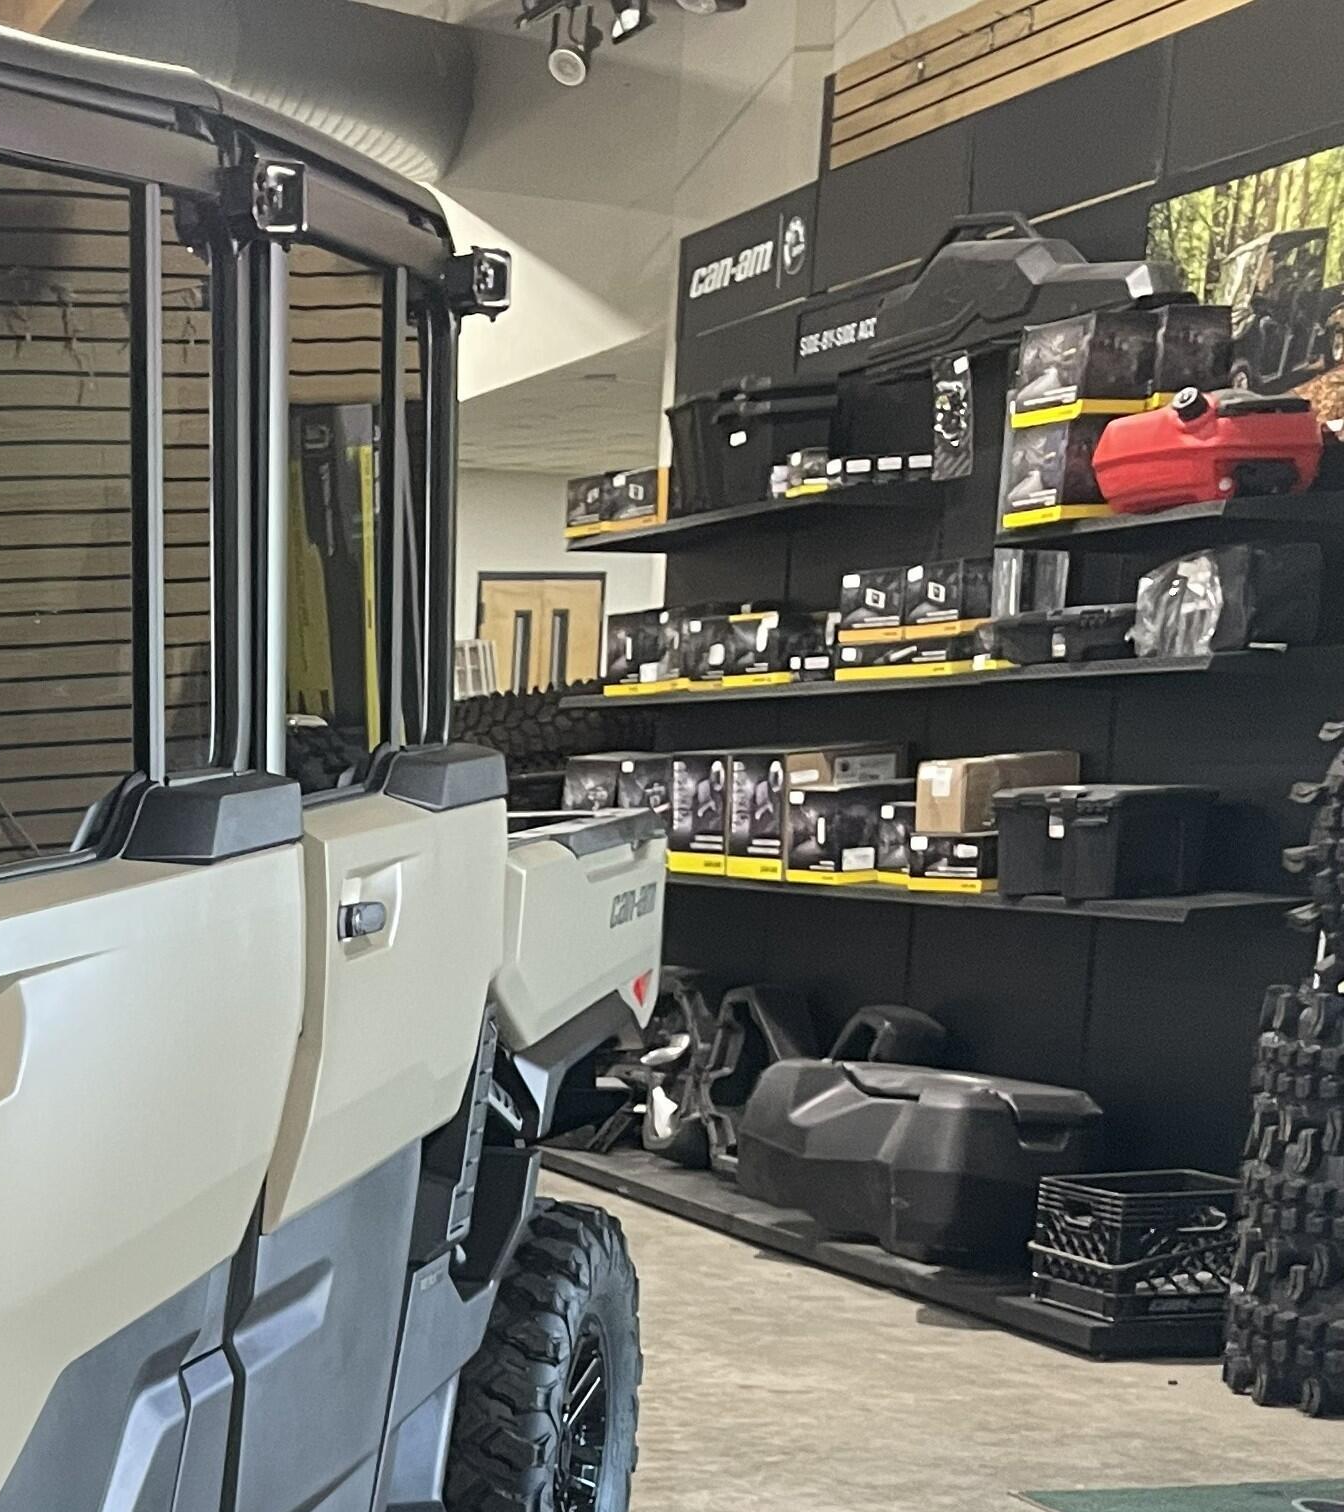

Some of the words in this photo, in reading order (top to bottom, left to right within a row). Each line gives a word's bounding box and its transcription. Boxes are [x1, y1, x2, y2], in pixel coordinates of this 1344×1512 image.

[689, 240, 774, 299] can-am
[799, 323, 857, 357] SIDE-BY-SIDE
[609, 882, 657, 929] can-am
